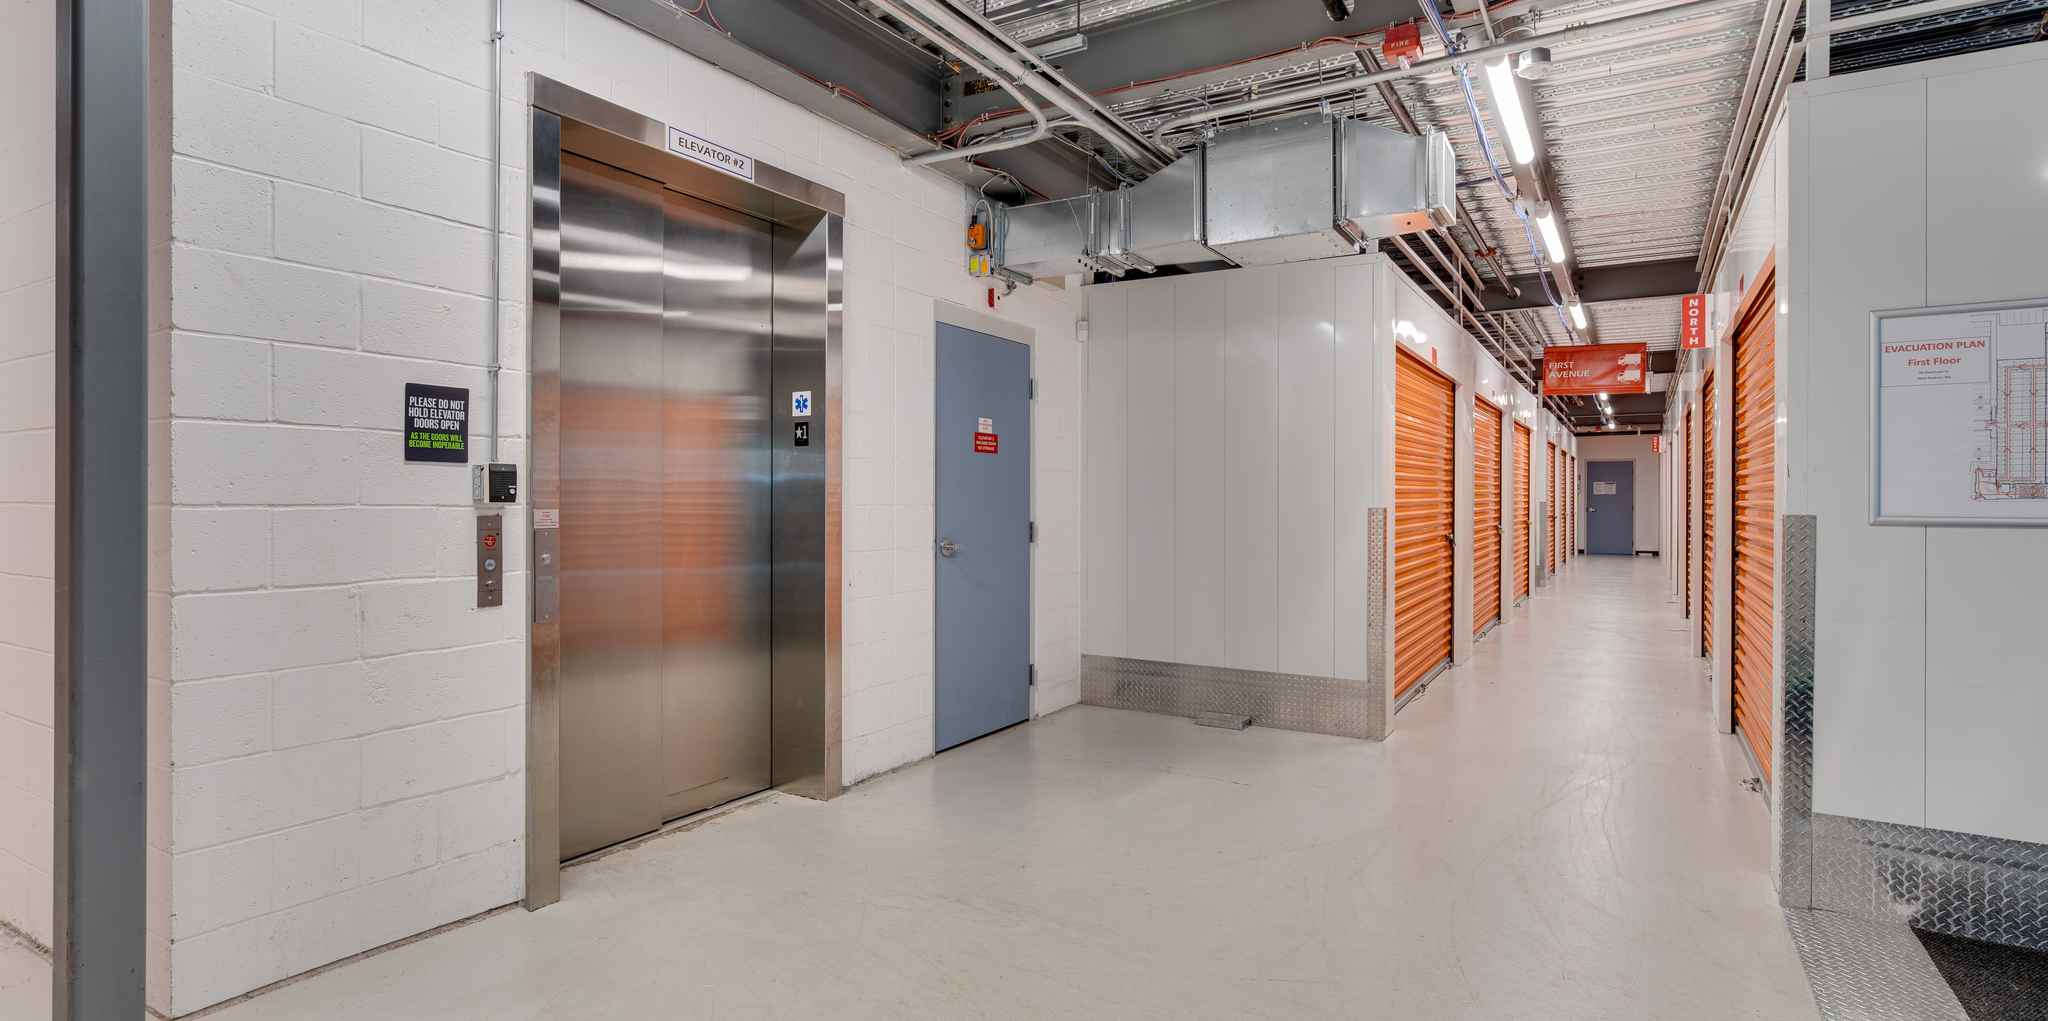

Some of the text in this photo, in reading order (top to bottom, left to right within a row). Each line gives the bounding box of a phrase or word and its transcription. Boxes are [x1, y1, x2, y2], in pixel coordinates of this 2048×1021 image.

[1391, 39, 1409, 49] FIRE
[678, 137, 745, 169] ELEVATOR #2
[1688, 298, 1699, 345] NORTH
[1884, 339, 1986, 353] EVACUATION PLAN
[1549, 361, 1575, 370] FIRST
[1908, 357, 1962, 367] First Floor
[1549, 369, 1591, 379] AVENUE
[409, 396, 465, 410] PLEASE DO NOT
[408, 407, 465, 420] HOLD ELEVATOR
[414, 418, 460, 431] DOORS OPEN
[410, 432, 462, 442] AS THE DOORS WILL
[408, 440, 431, 448] BECOME
